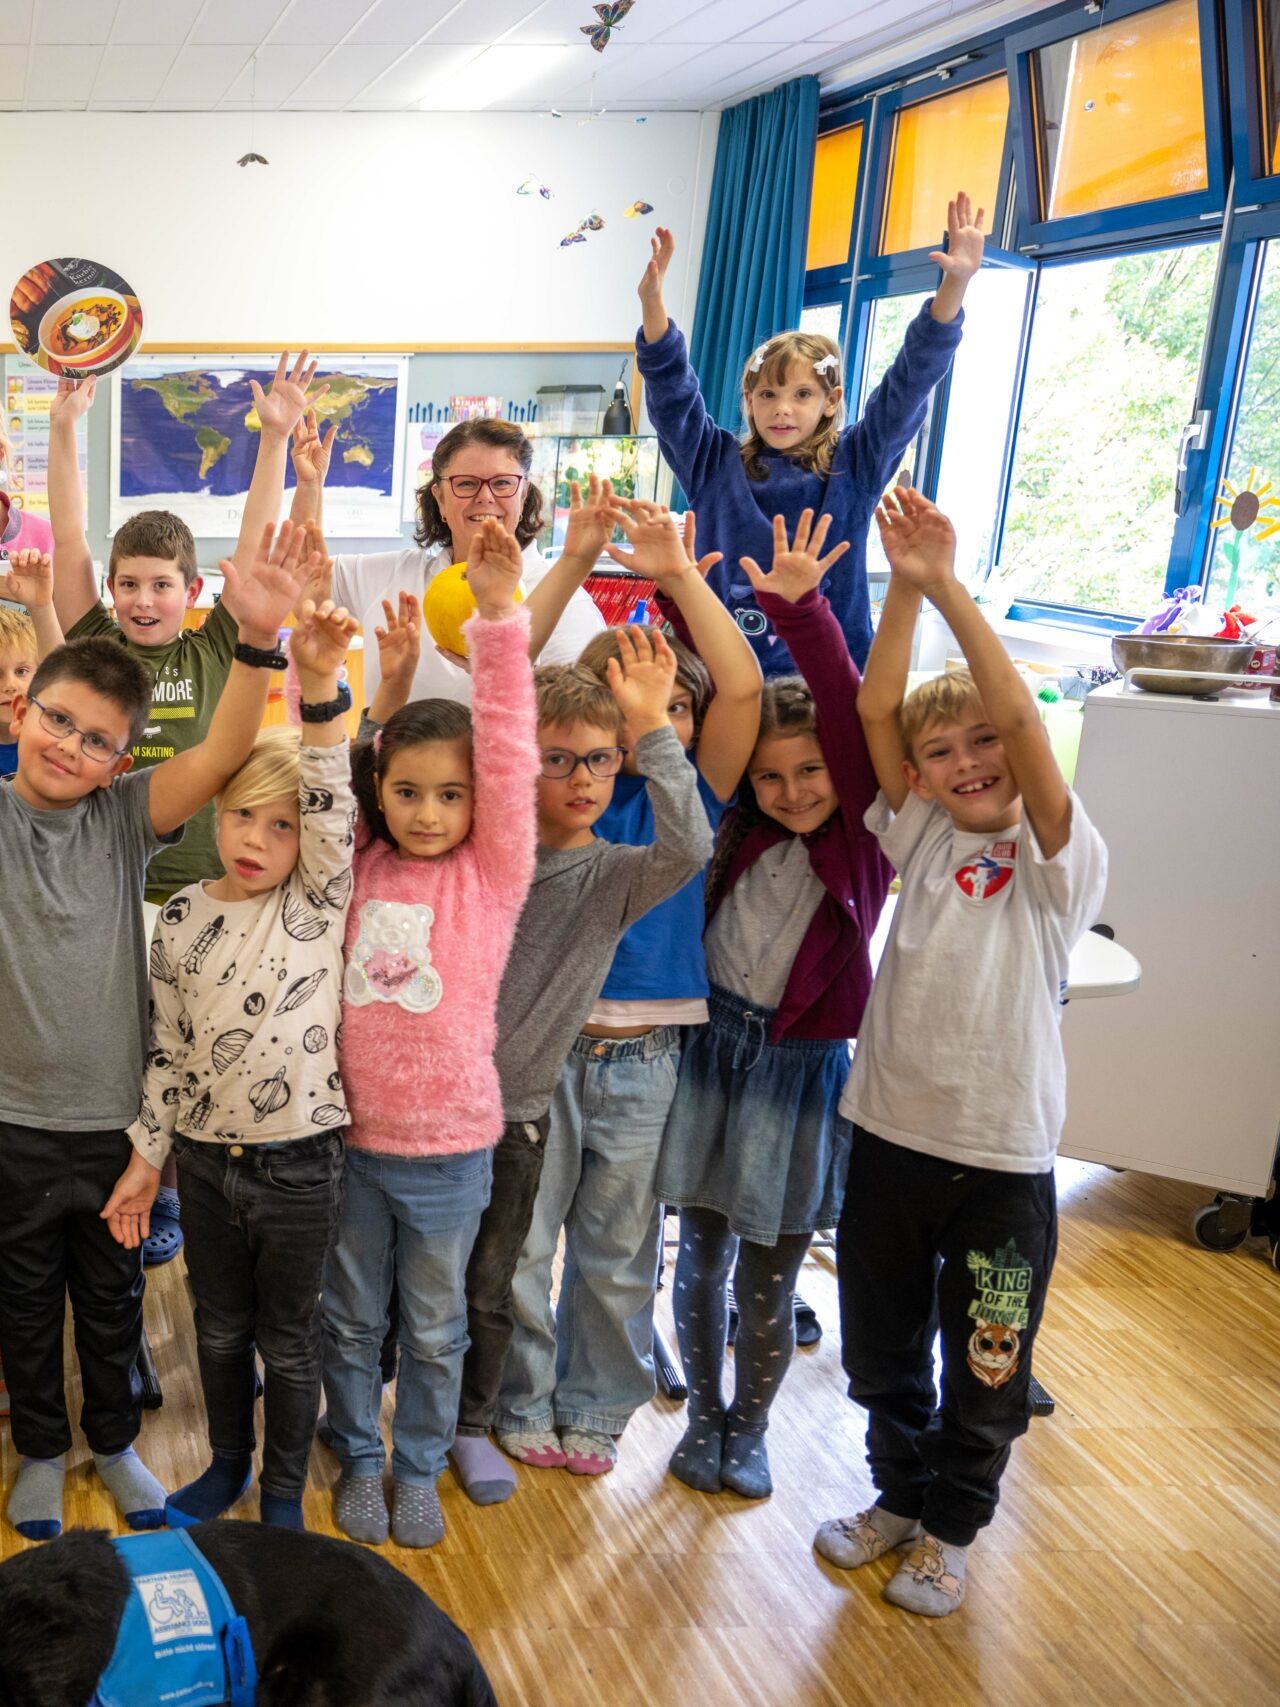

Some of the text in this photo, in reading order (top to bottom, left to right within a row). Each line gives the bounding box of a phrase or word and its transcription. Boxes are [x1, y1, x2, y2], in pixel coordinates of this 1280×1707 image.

[152, 678, 194, 702] MORE
[141, 746, 174, 758] SKATING
[981, 1270, 1027, 1291] KING
[985, 1291, 1024, 1308] OF THE
